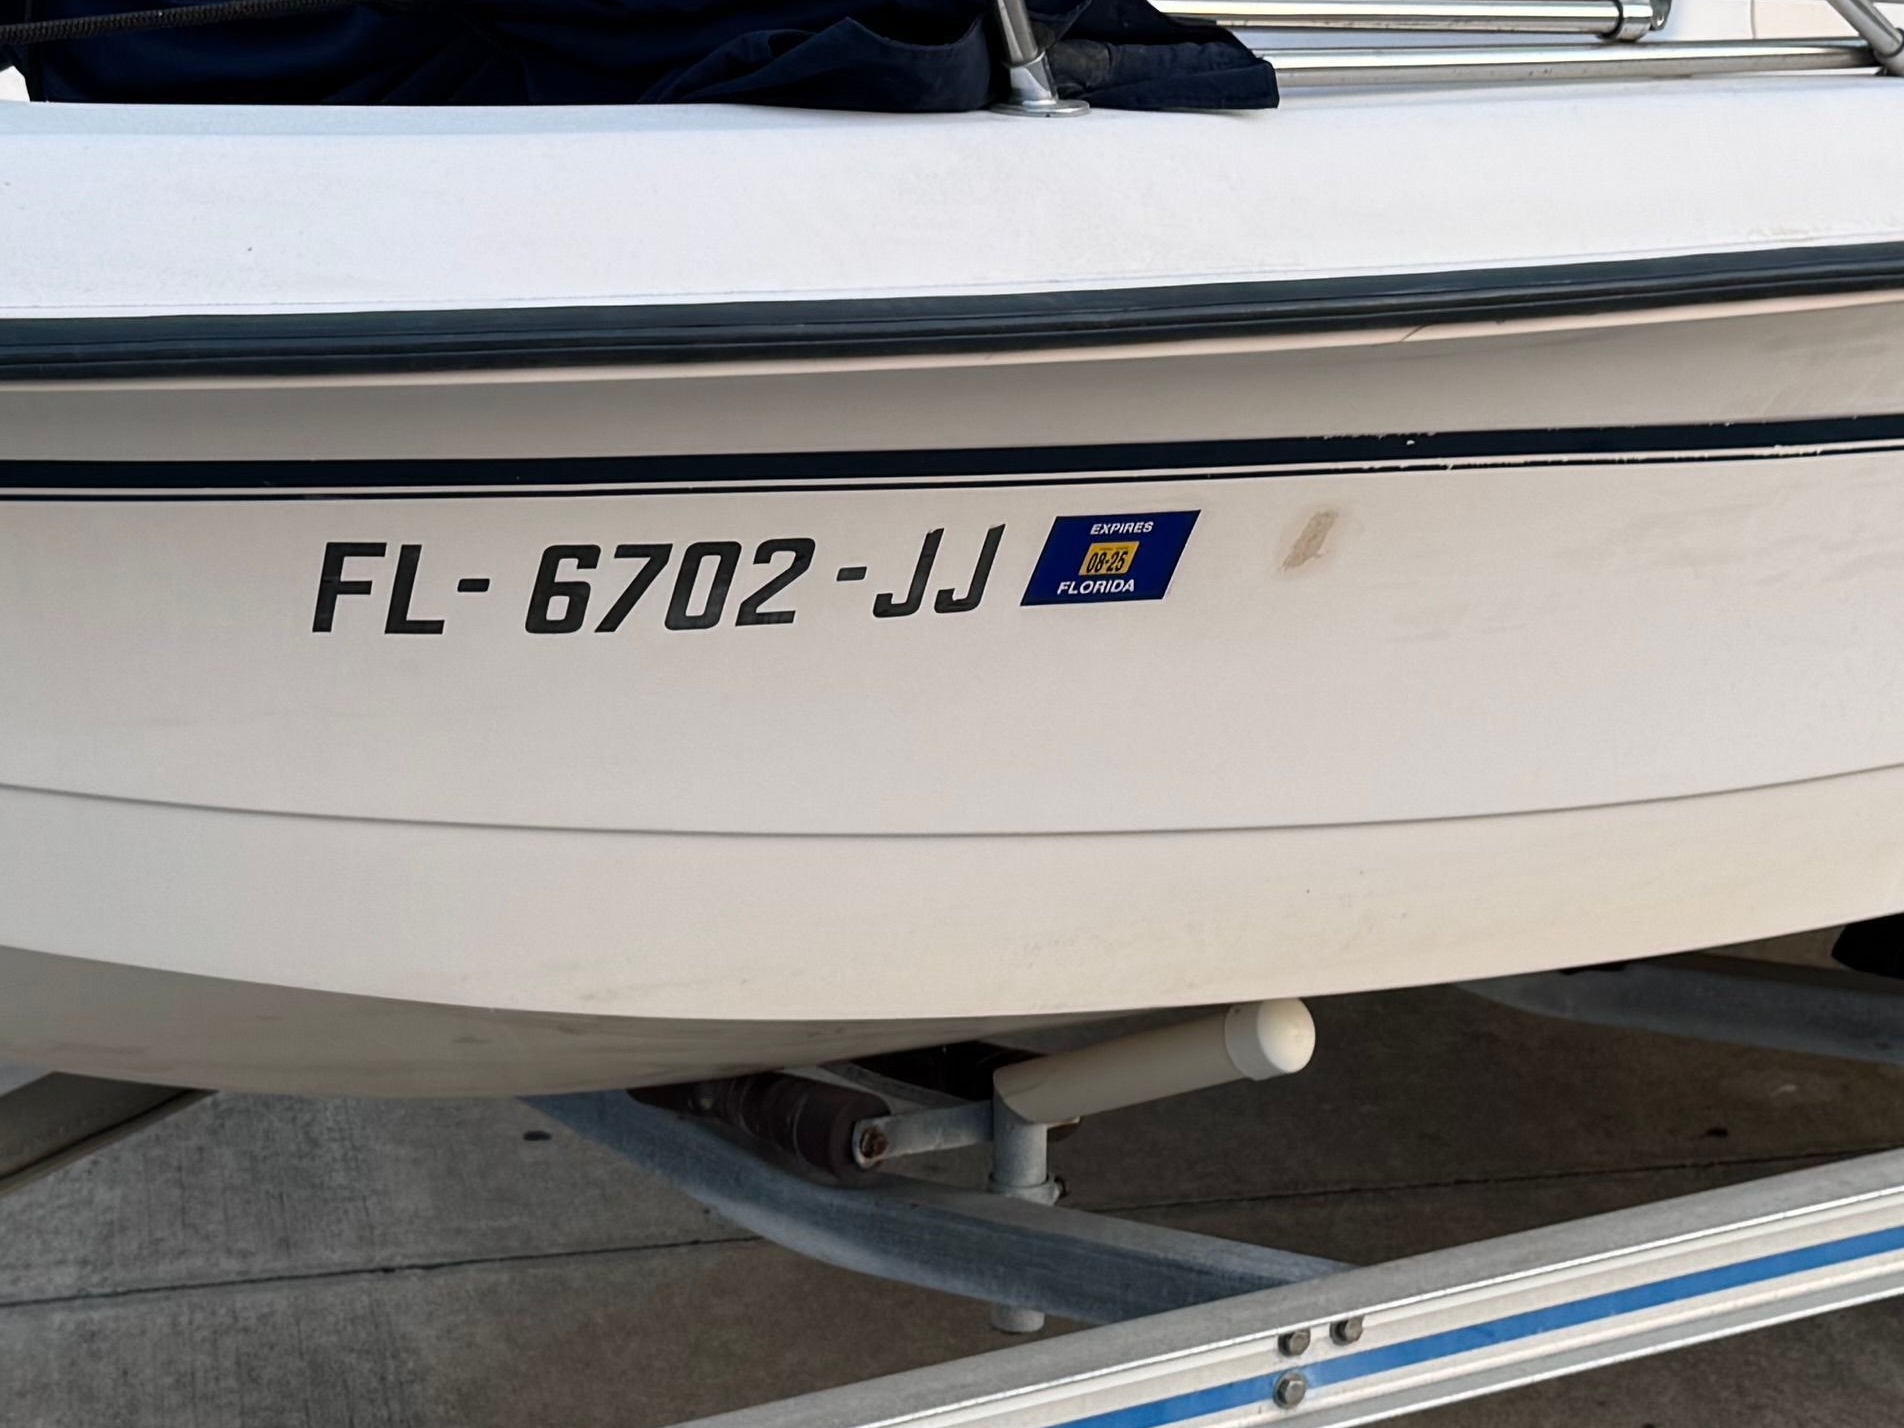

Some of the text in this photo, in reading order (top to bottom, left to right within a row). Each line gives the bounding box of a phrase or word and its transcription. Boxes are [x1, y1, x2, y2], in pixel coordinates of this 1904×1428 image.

[1091, 522, 1154, 535] EXPIRES
[1086, 552, 1128, 573] 08-25
[1057, 579, 1135, 595] FLORIDA
